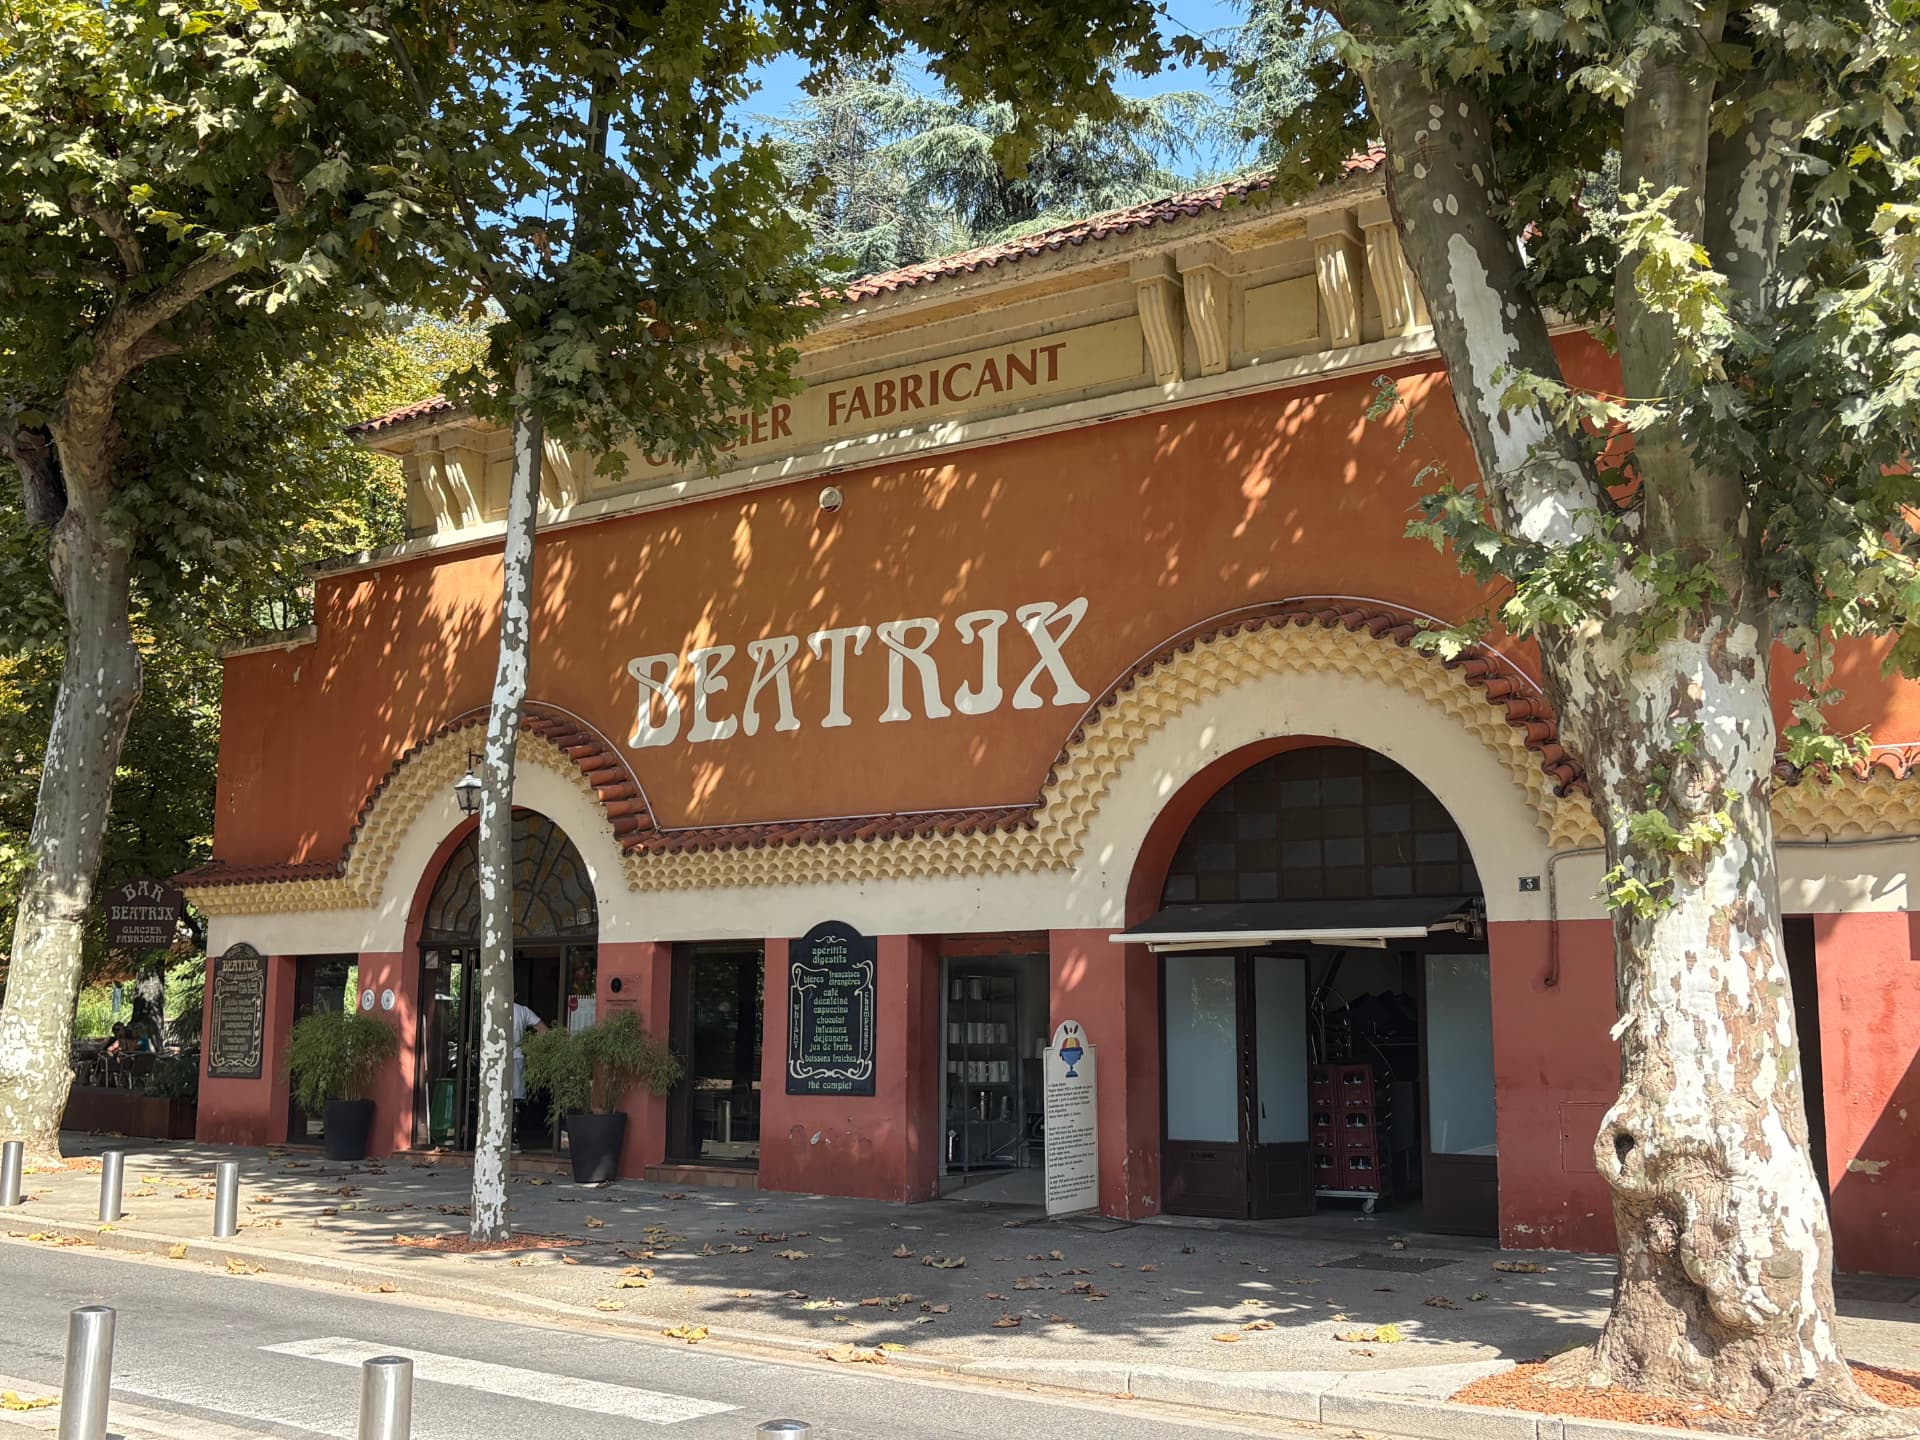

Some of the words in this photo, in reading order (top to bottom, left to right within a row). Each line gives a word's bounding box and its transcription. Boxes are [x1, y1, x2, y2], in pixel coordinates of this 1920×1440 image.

[645, 403, 793, 467] CIER
[828, 342, 1067, 427] FABRICANT
[627, 597, 1091, 749] BEATRIX
[121, 881, 164, 903] BAR
[111, 905, 175, 920] BEATRIX
[122, 926, 162, 934] GLACIER
[812, 955, 848, 966] digestifs
[816, 1015, 845, 1024] chocolat
[815, 1024, 848, 1033] infusions
[809, 1042, 821, 1053] jus
[822, 1043, 832, 1051] de
[833, 1042, 853, 1051] fruits
[804, 1053, 831, 1063] boissons
[822, 1081, 852, 1092] complet
